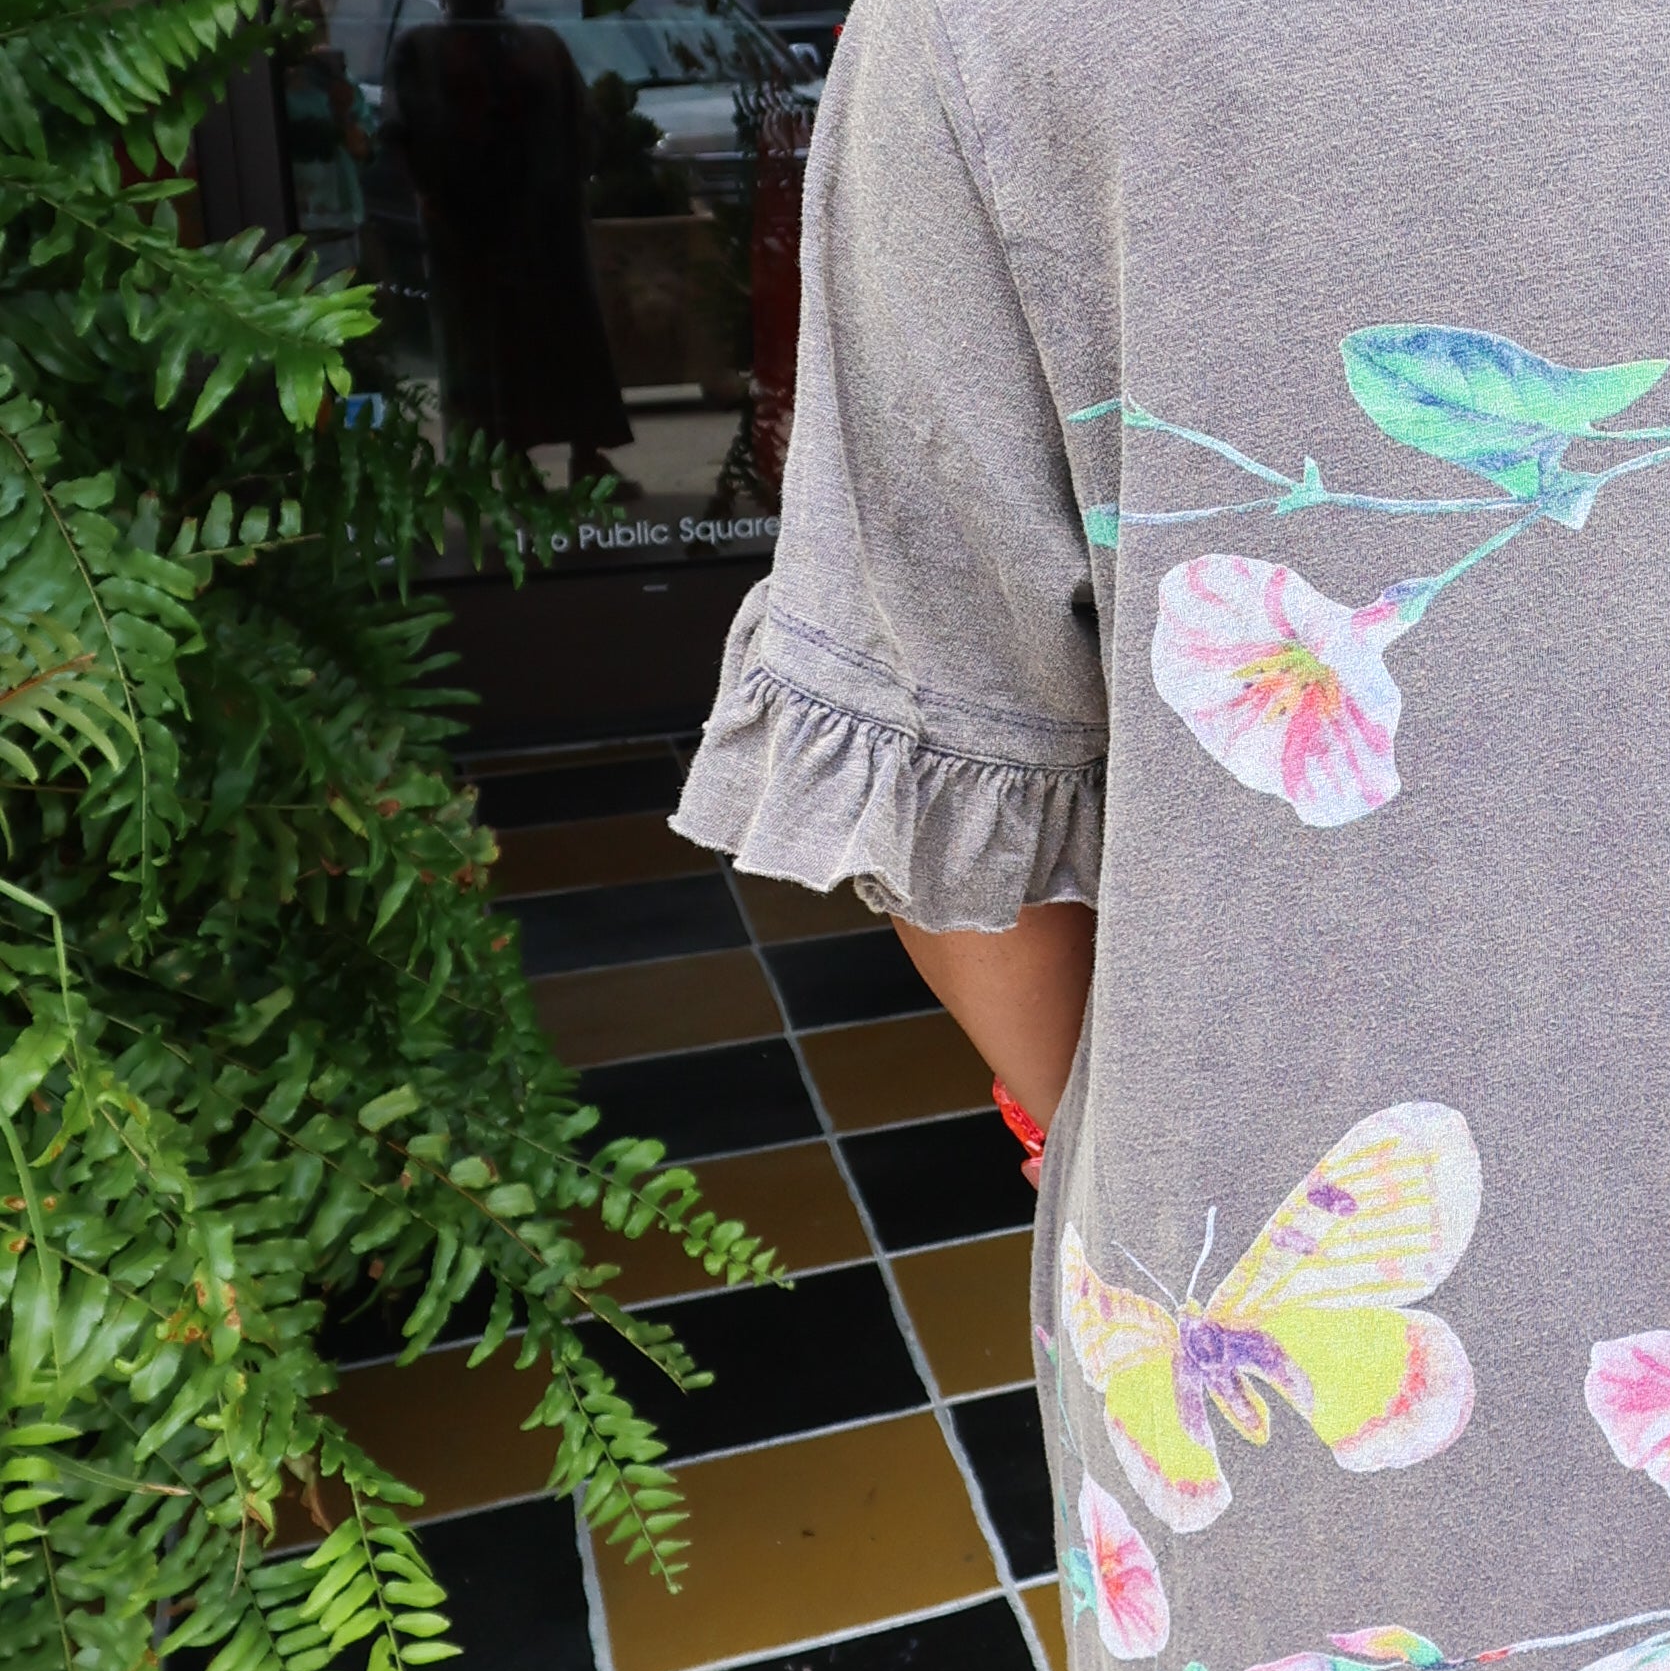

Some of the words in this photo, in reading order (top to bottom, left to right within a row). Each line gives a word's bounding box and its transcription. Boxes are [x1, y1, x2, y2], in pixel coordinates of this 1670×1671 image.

[515, 527, 569, 553] 16
[578, 520, 670, 550] Public
[679, 516, 781, 545] Square
